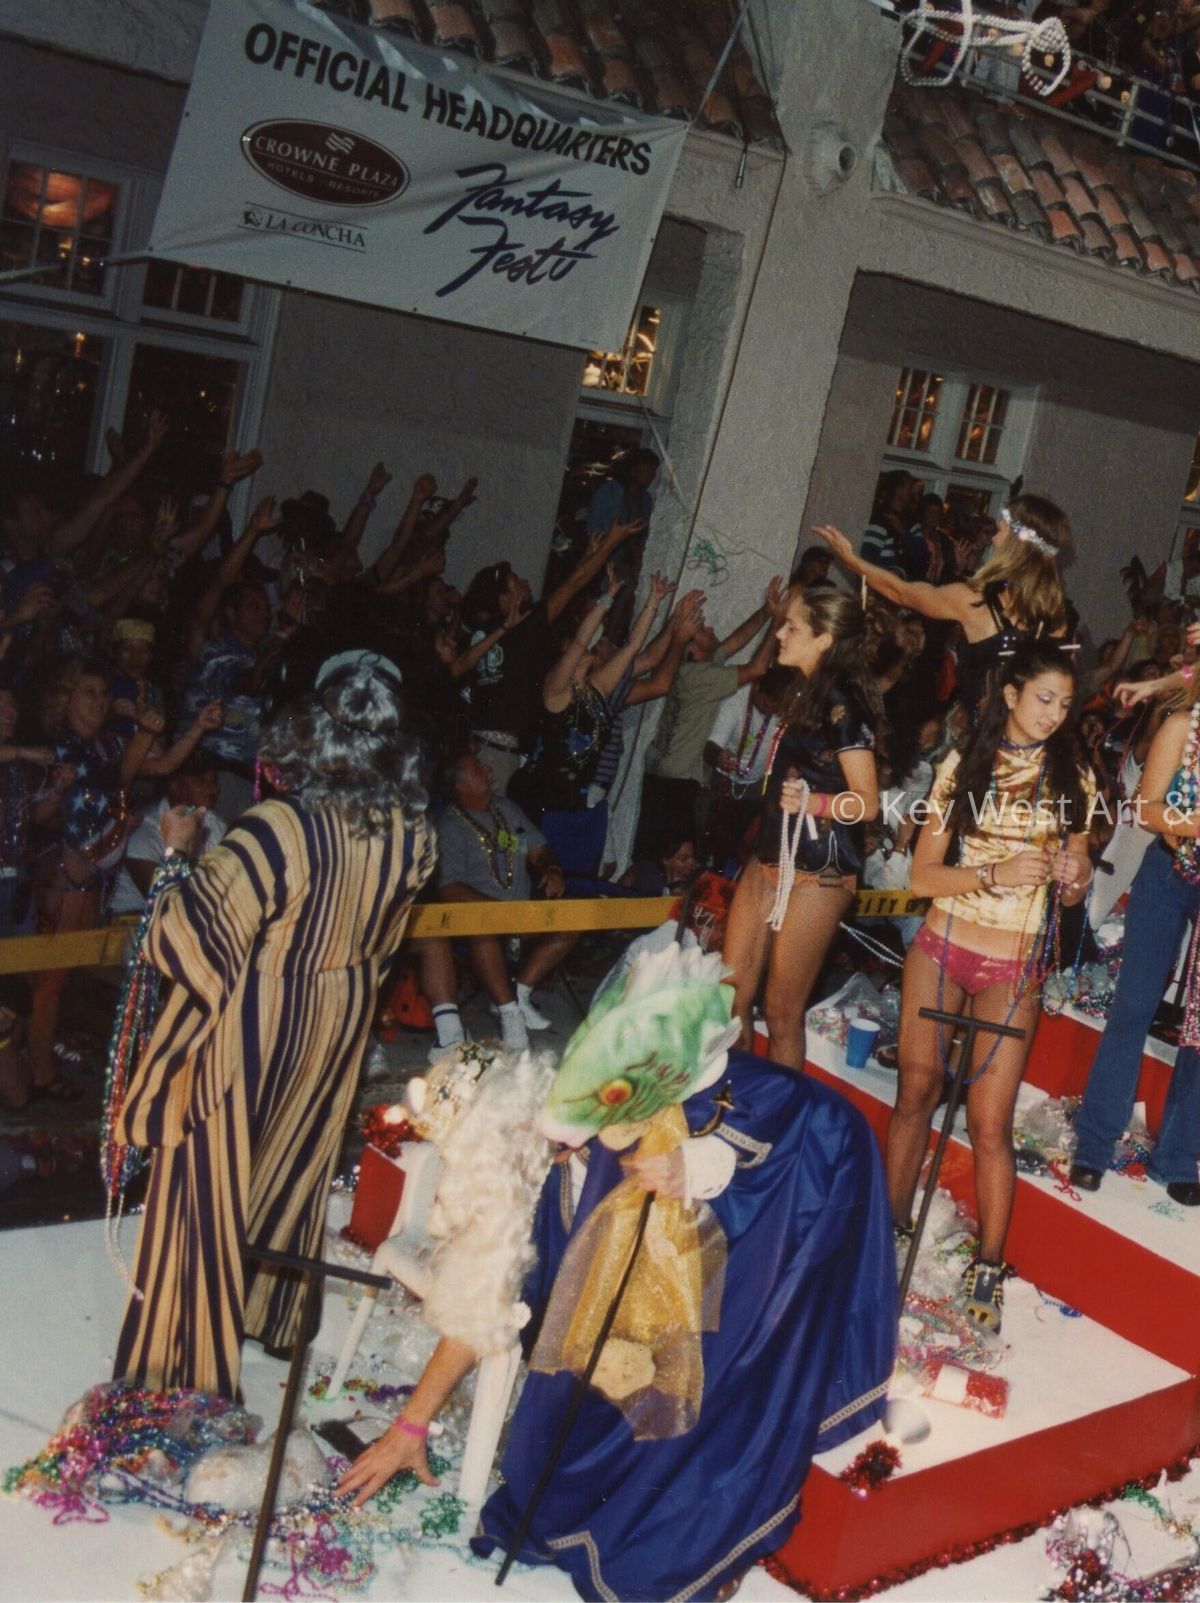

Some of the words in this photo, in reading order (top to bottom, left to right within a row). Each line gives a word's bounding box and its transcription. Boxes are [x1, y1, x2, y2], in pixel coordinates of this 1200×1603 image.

[243, 22, 410, 113] OFFICIAL
[422, 82, 652, 176] HEADQUARTERS
[255, 136, 341, 172] CROWNE
[348, 162, 398, 187] PLAZA
[266, 161, 316, 184] HOTELS
[265, 214, 287, 231] LA
[423, 163, 620, 281] Fantasy
[435, 215, 598, 297] Fest
